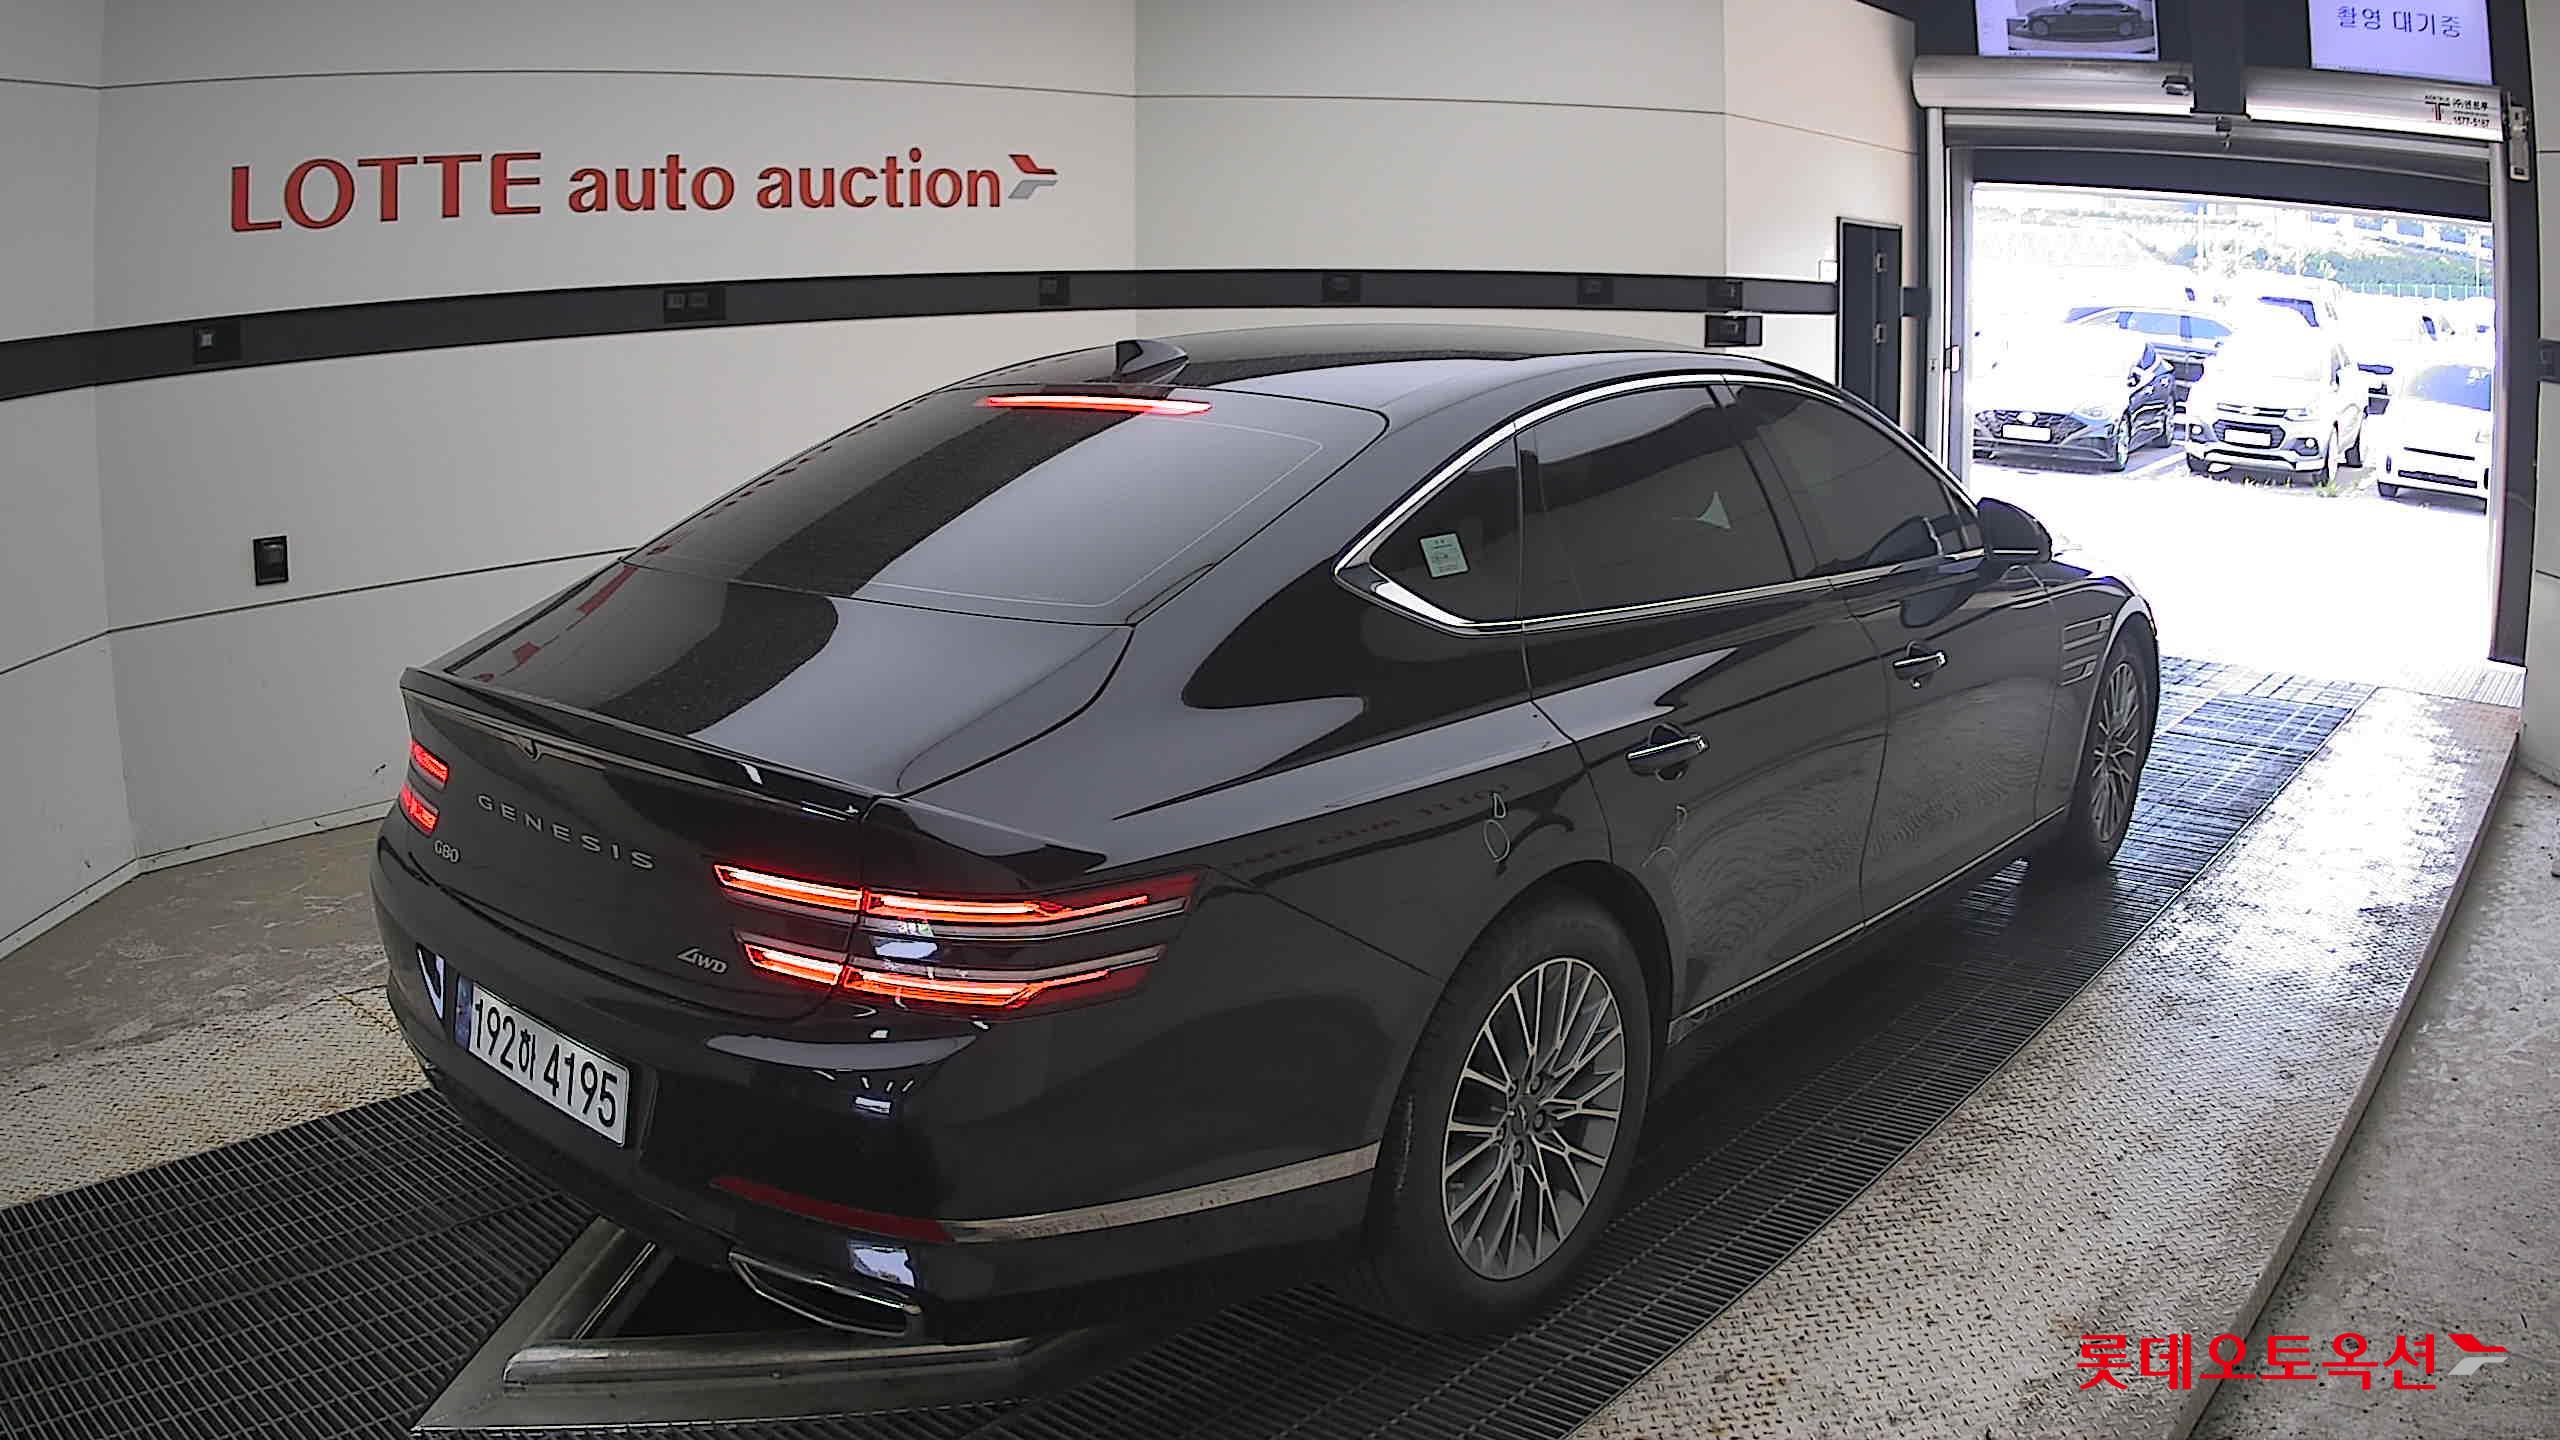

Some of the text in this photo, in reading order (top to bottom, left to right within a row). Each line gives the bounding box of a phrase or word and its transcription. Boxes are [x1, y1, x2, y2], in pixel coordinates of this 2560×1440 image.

[2337, 5, 2463, 38] 촬영 대기중
[231, 148, 1001, 232] LOTTE auto auction
[434, 840, 460, 863] G80
[477, 795, 654, 870] GENESIS
[474, 998, 618, 1128] 192하 4195
